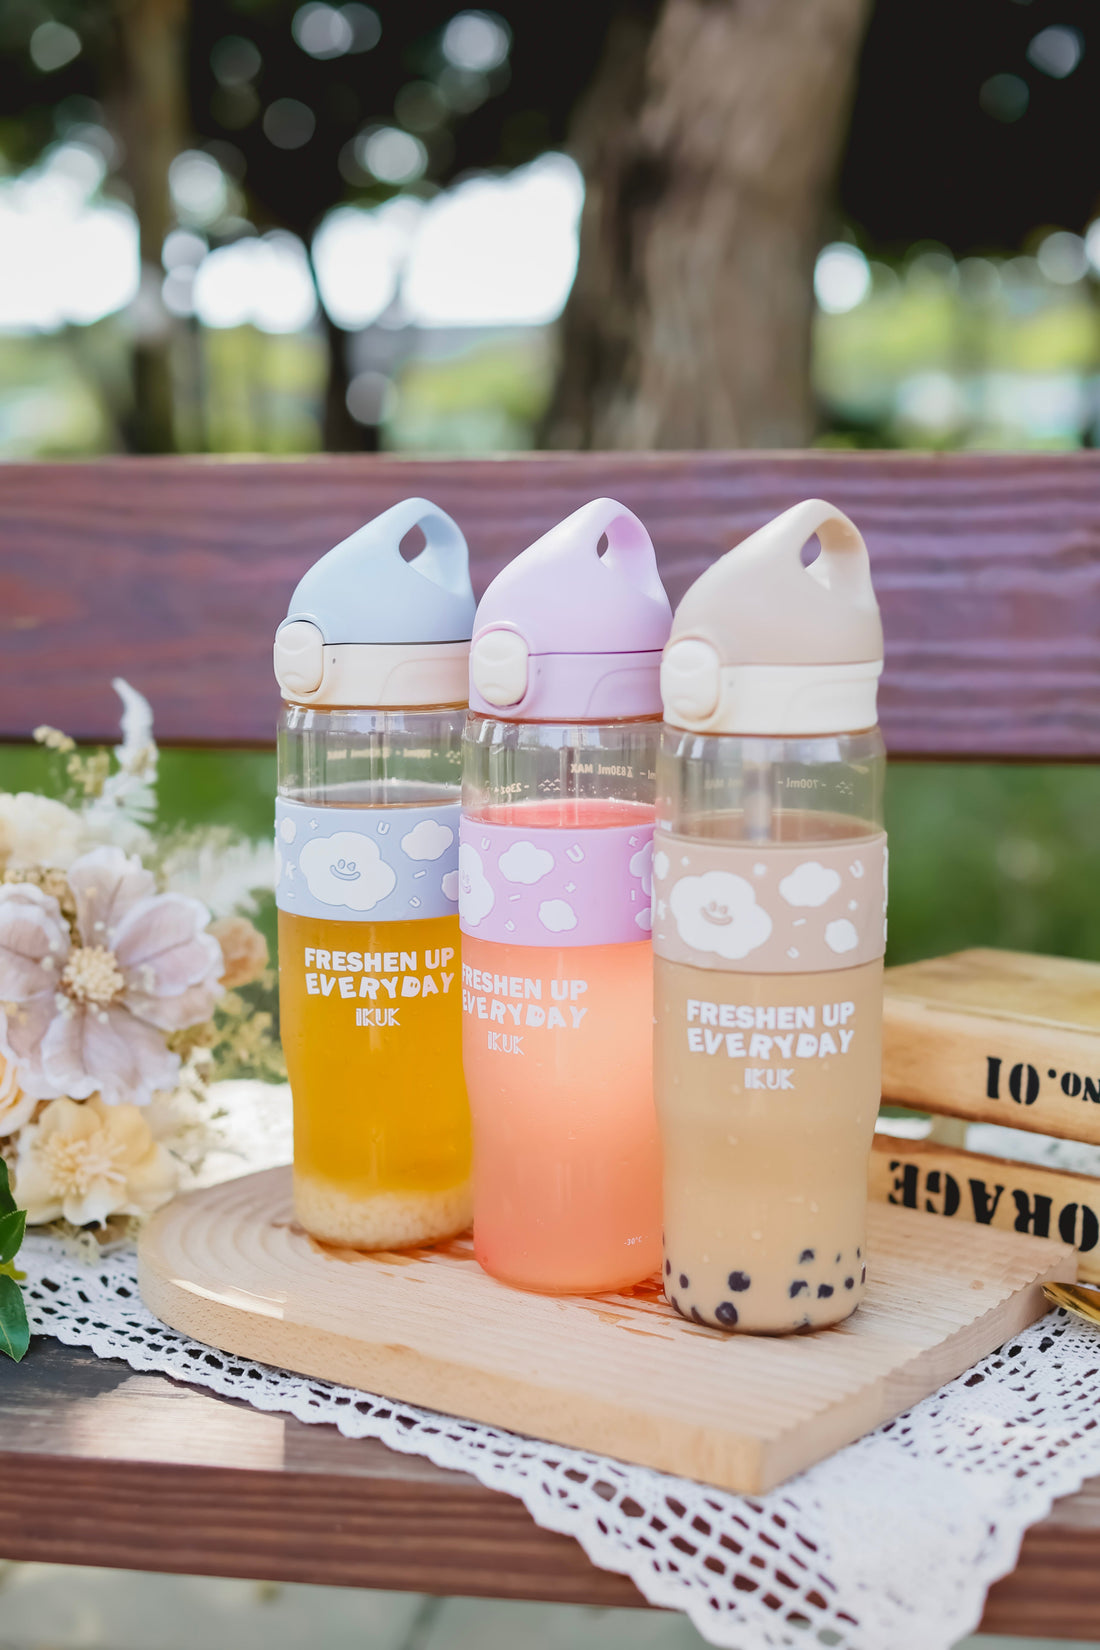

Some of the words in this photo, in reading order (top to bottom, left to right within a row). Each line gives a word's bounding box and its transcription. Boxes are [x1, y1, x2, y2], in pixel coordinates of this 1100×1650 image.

[304, 947, 417, 973] FRESHEN
[425, 947, 455, 970] UP
[305, 972, 455, 1000] EVERYDAY
[462, 962, 542, 1000] FRESHEN
[550, 979, 588, 1001] UP
[355, 1007, 401, 1027] IKUK
[462, 988, 588, 1030] EVERYDAY
[687, 999, 816, 1030] FRESHEN
[822, 1001, 856, 1027] UP
[487, 1030, 525, 1056] IKUK
[687, 1027, 855, 1060] EVERYDAY
[744, 1067, 795, 1090] IKUK
[888, 1161, 1099, 1252] ORAGE
